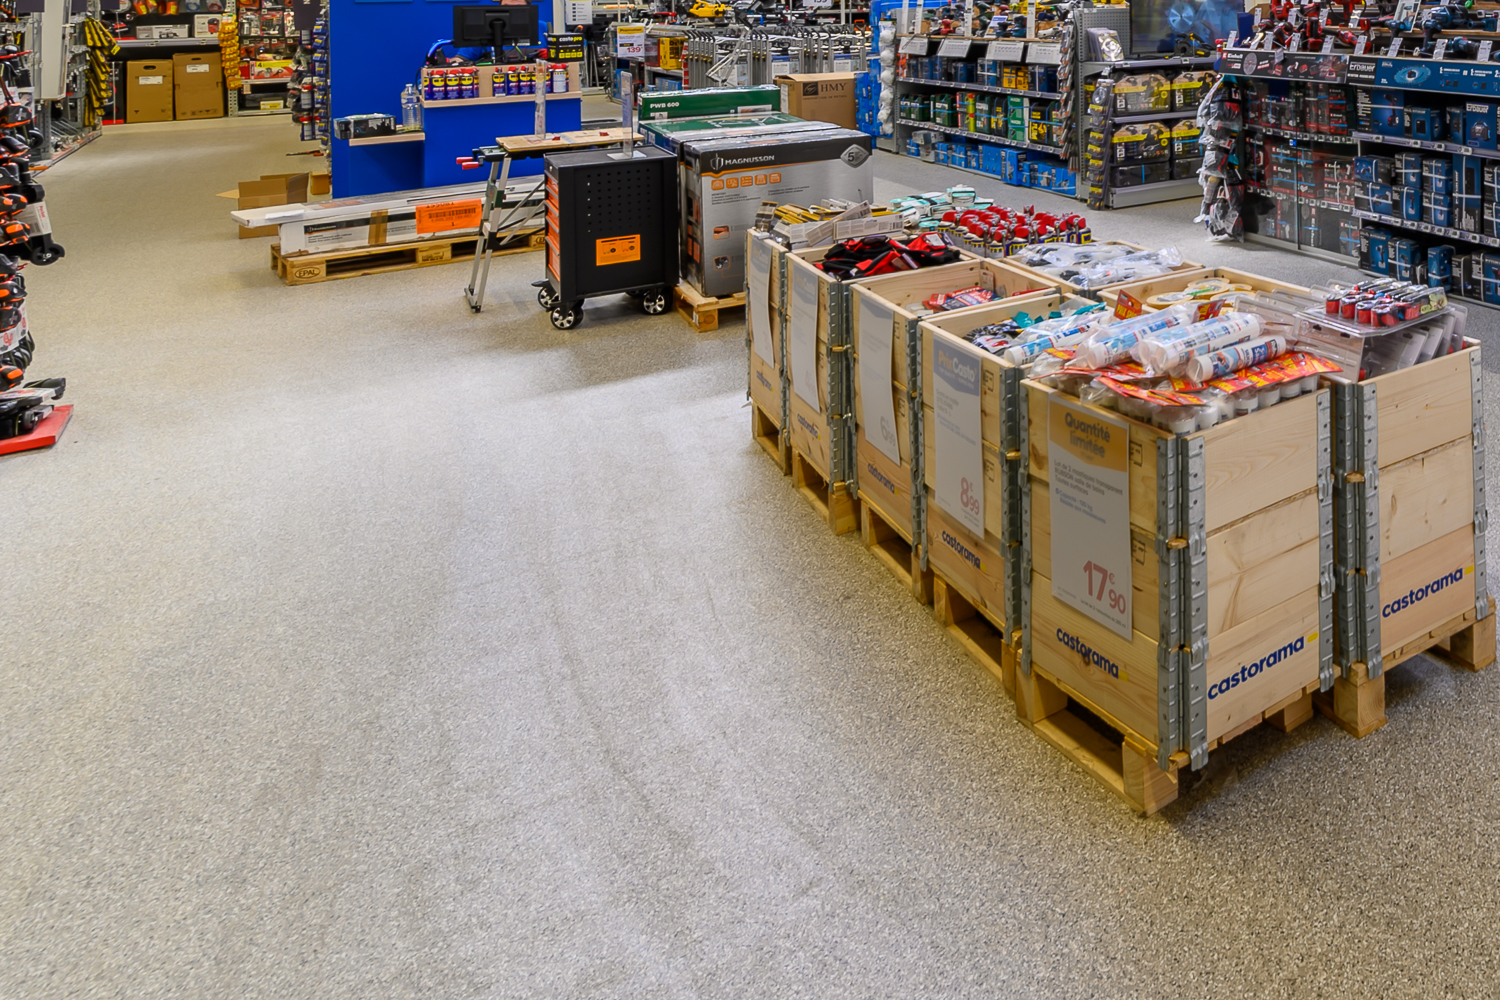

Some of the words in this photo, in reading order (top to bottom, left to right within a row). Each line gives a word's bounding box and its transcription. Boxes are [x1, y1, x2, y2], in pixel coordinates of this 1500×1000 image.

[1350, 62, 1376, 73] Erbauer
[821, 83, 847, 92] HMY
[1466, 102, 1489, 114] Erbauer
[724, 154, 775, 165] MAGNUSSON
[847, 152, 855, 162] 5
[1065, 412, 1110, 443] Quantité
[1069, 430, 1105, 458] limitée
[868, 463, 895, 494] castorama
[942, 531, 980, 570] castorama
[1382, 568, 1463, 618] castorama
[1056, 628, 1119, 679] castorama
[1207, 636, 1304, 700] castorama
